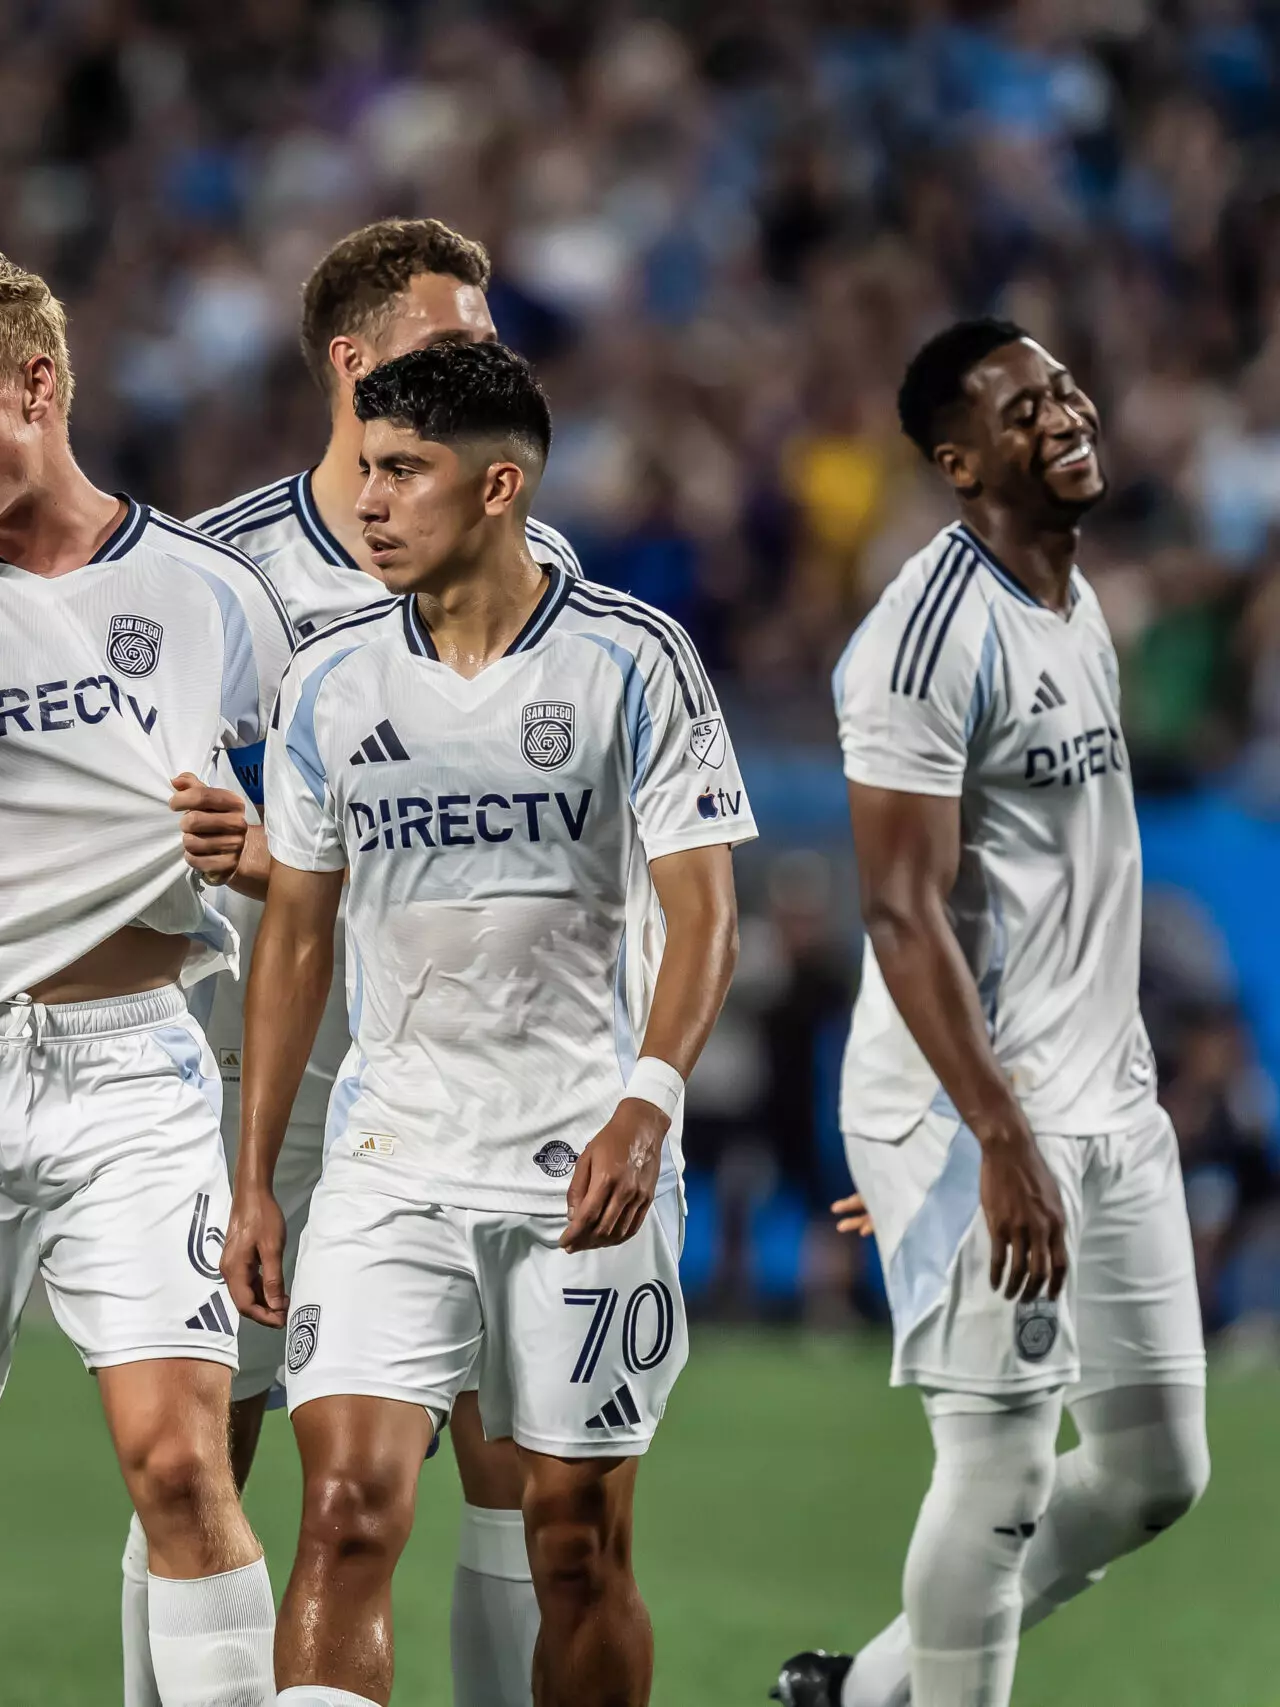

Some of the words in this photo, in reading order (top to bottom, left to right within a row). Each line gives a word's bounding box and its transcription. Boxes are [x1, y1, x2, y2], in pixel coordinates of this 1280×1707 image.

[114, 618, 134, 631] SAN
[134, 620, 159, 640] DIEGO
[129, 649, 139, 659] FC
[526, 705, 544, 721] SAN
[545, 705, 571, 720] DIEGO
[692, 725, 712, 738] MLS
[542, 739, 553, 748] FC
[717, 787, 741, 816] tv
[348, 788, 593, 852] DIRECTV
[561, 1278, 674, 1384] 70
